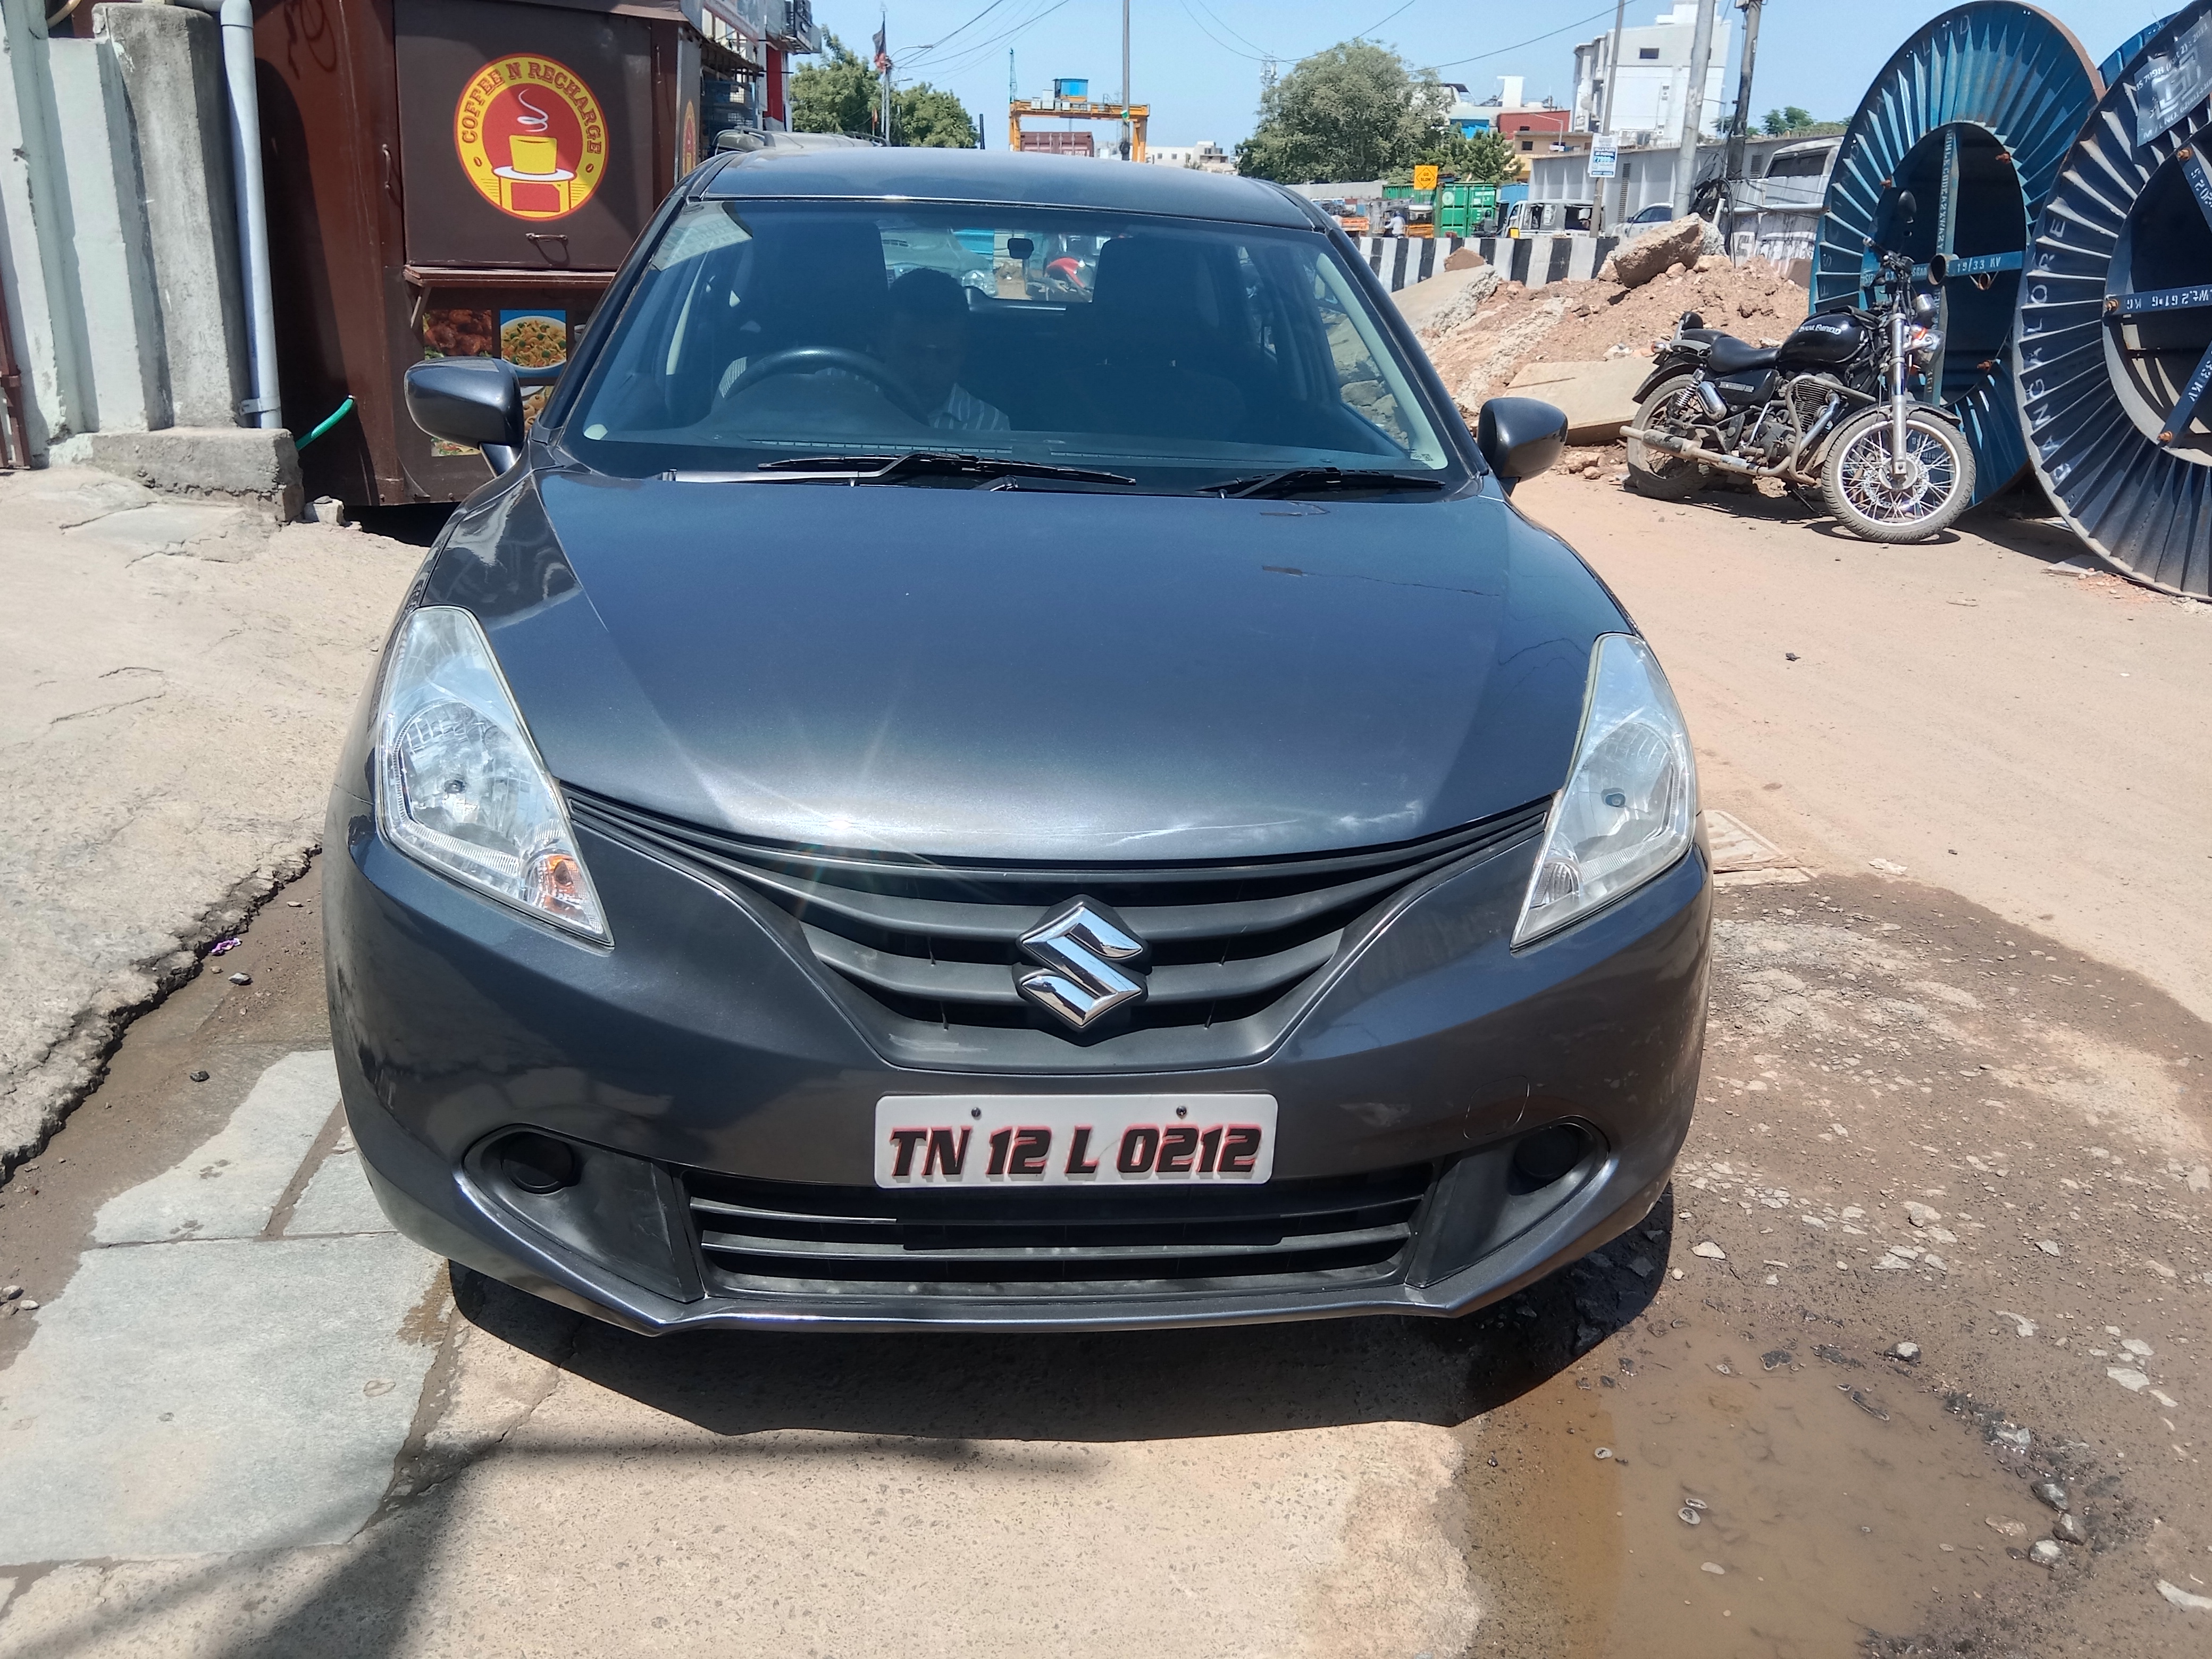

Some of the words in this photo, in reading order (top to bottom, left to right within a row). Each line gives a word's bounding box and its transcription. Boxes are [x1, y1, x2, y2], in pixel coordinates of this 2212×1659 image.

[462, 71, 506, 144] COFFEE
[506, 62, 523, 80] N
[528, 61, 601, 154] RECHARGE
[1957, 258, 1985, 273] 19/33
[889, 1125, 972, 1177] TN
[985, 1125, 1052, 1176] 12
[1064, 1124, 1100, 1174] L
[1116, 1123, 1262, 1174] 0212
